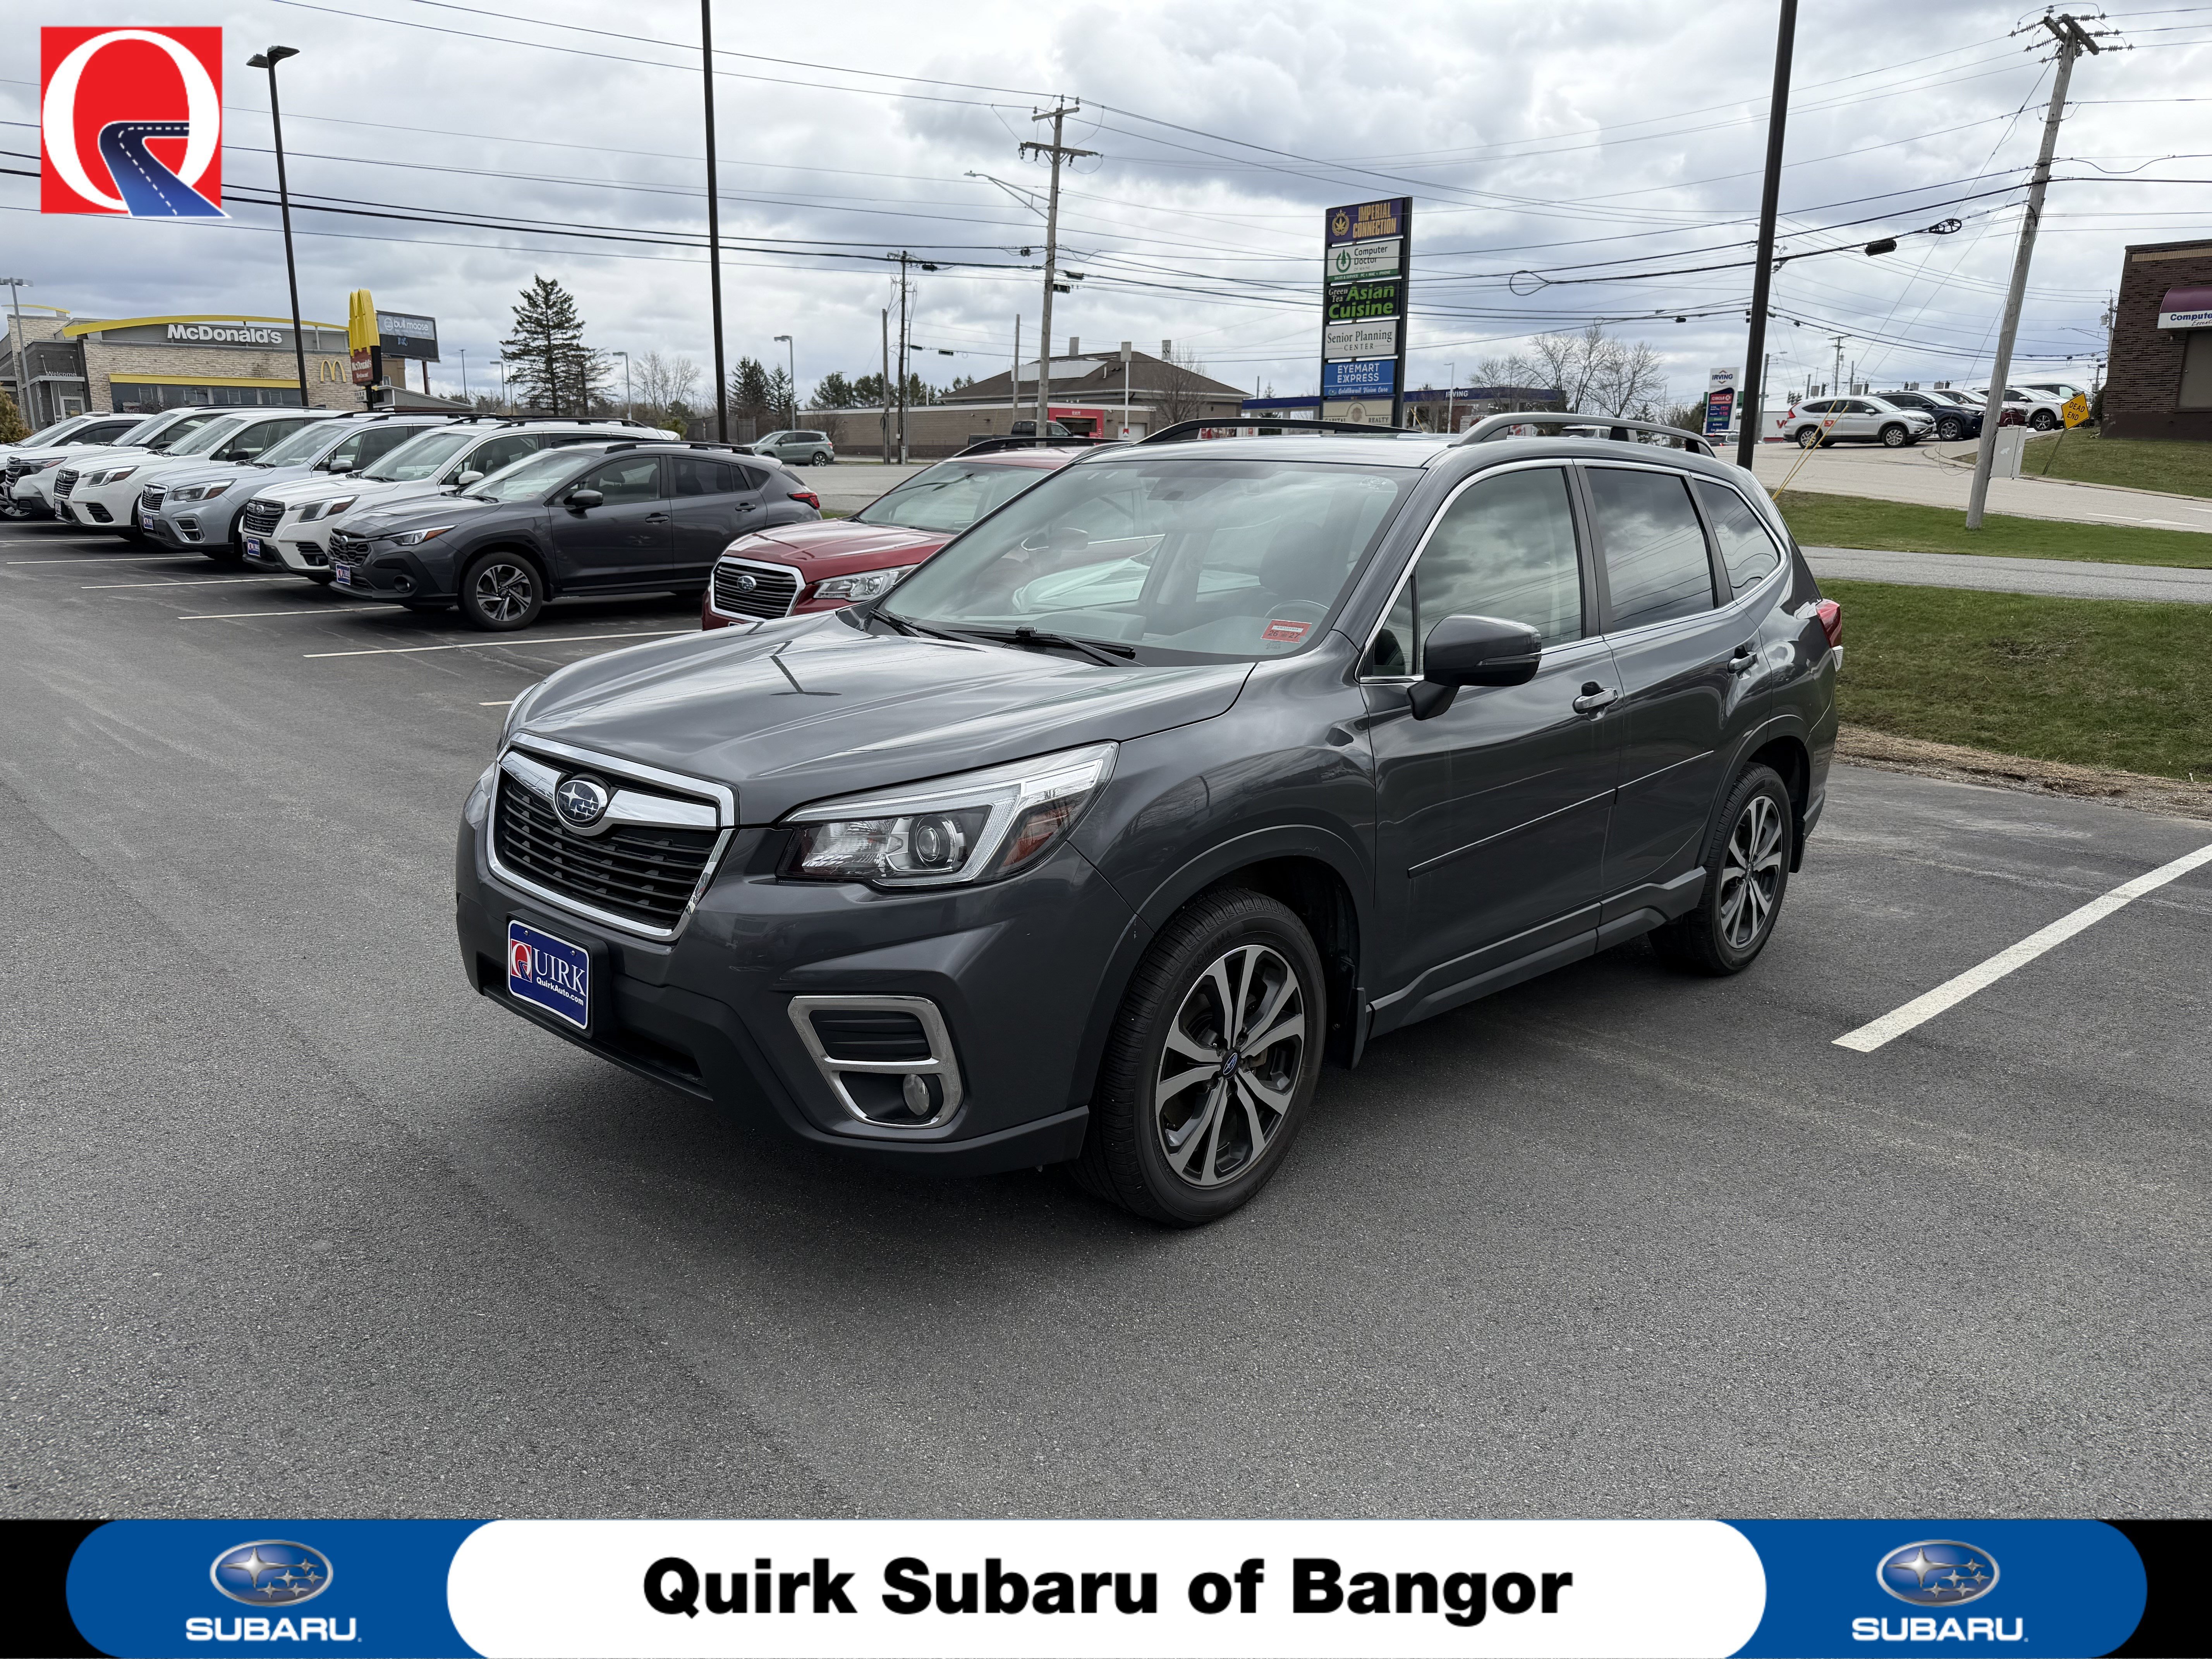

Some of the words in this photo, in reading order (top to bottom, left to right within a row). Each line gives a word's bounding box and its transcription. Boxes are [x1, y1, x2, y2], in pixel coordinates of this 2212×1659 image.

[1358, 203, 1391, 222] IMPERIAL
[1353, 217, 1396, 238] CONNECTION
[1354, 246, 1388, 256] Computer
[1346, 284, 1394, 301] Asian
[1328, 301, 1393, 319] Cuisine
[393, 319, 405, 329] bull
[407, 322, 428, 331] moose
[167, 324, 282, 344] McDonald's
[1327, 333, 1353, 343] Senior
[1355, 330, 1393, 342] Planning
[1338, 363, 1380, 373] EYEMART
[1337, 373, 1379, 383] EXPRESS
[2067, 411, 2079, 420] END
[2069, 402, 2085, 412] DEAD
[1180, 930, 1232, 984] YOKOHAMA
[511, 943, 586, 997] QUIRK
[536, 977, 584, 1006] QuirkAuto.com
